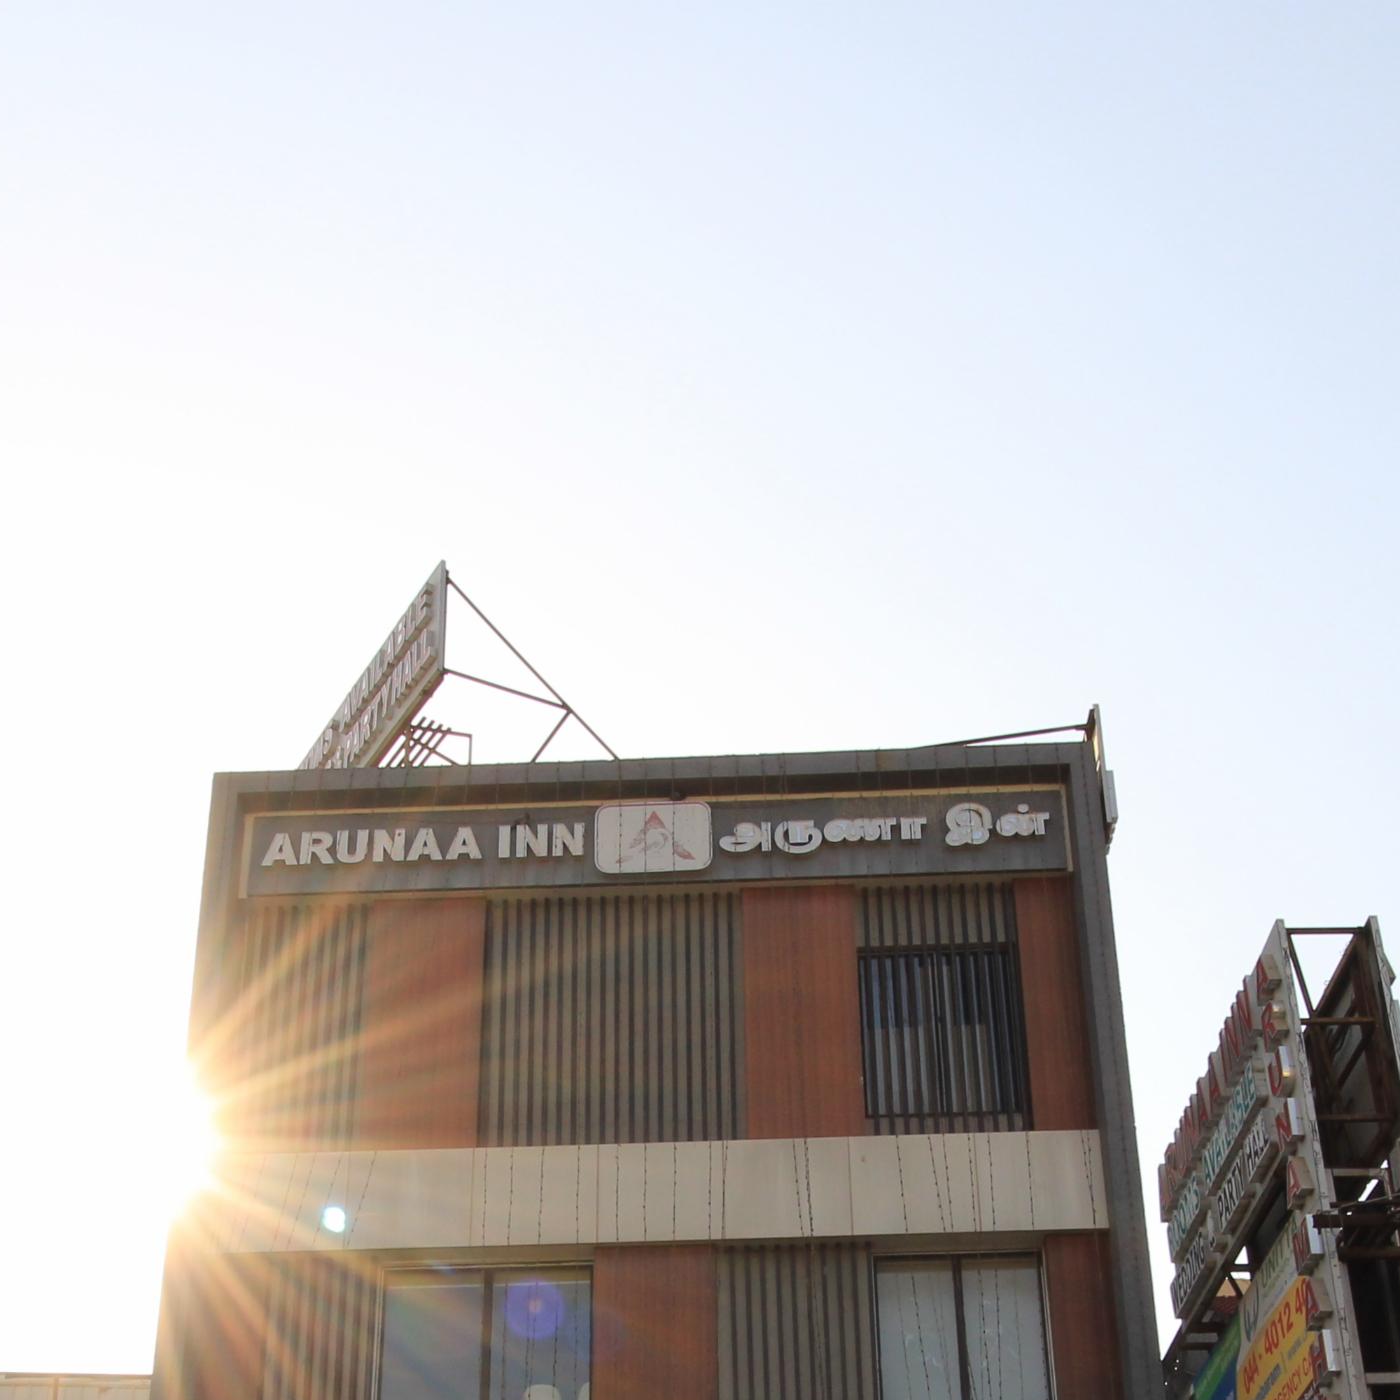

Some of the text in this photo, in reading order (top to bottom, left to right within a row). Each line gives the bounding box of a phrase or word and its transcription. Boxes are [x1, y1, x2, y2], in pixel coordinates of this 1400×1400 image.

[261, 822, 585, 867] ARUNAA INN
[719, 816, 926, 855] அருணா
